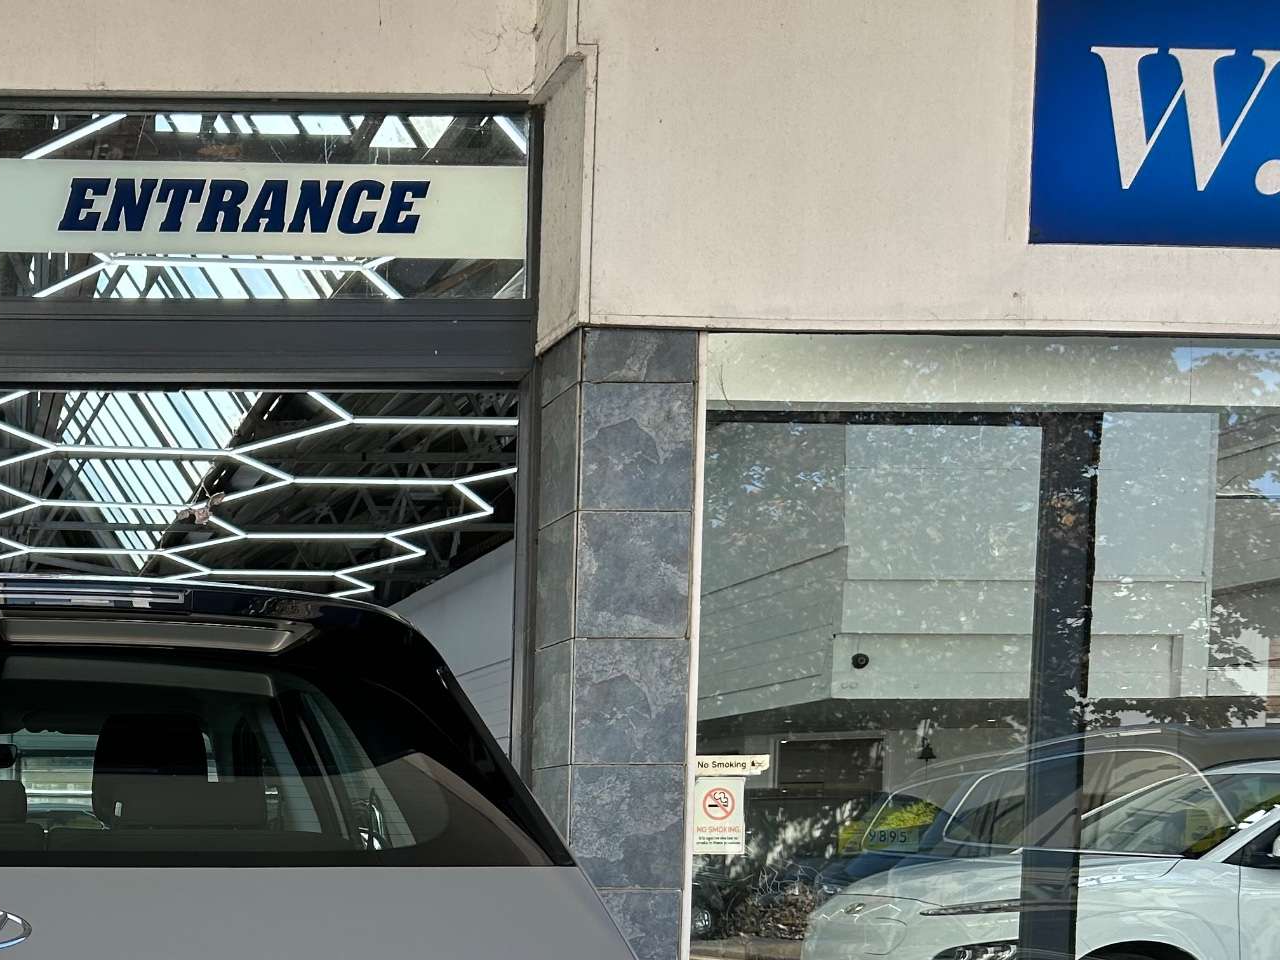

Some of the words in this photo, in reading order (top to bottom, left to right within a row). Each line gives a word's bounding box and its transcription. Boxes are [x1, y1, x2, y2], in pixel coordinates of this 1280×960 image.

[57, 177, 431, 235] ENTRANCE
[697, 761, 709, 769] No
[711, 760, 747, 769] Smoking
